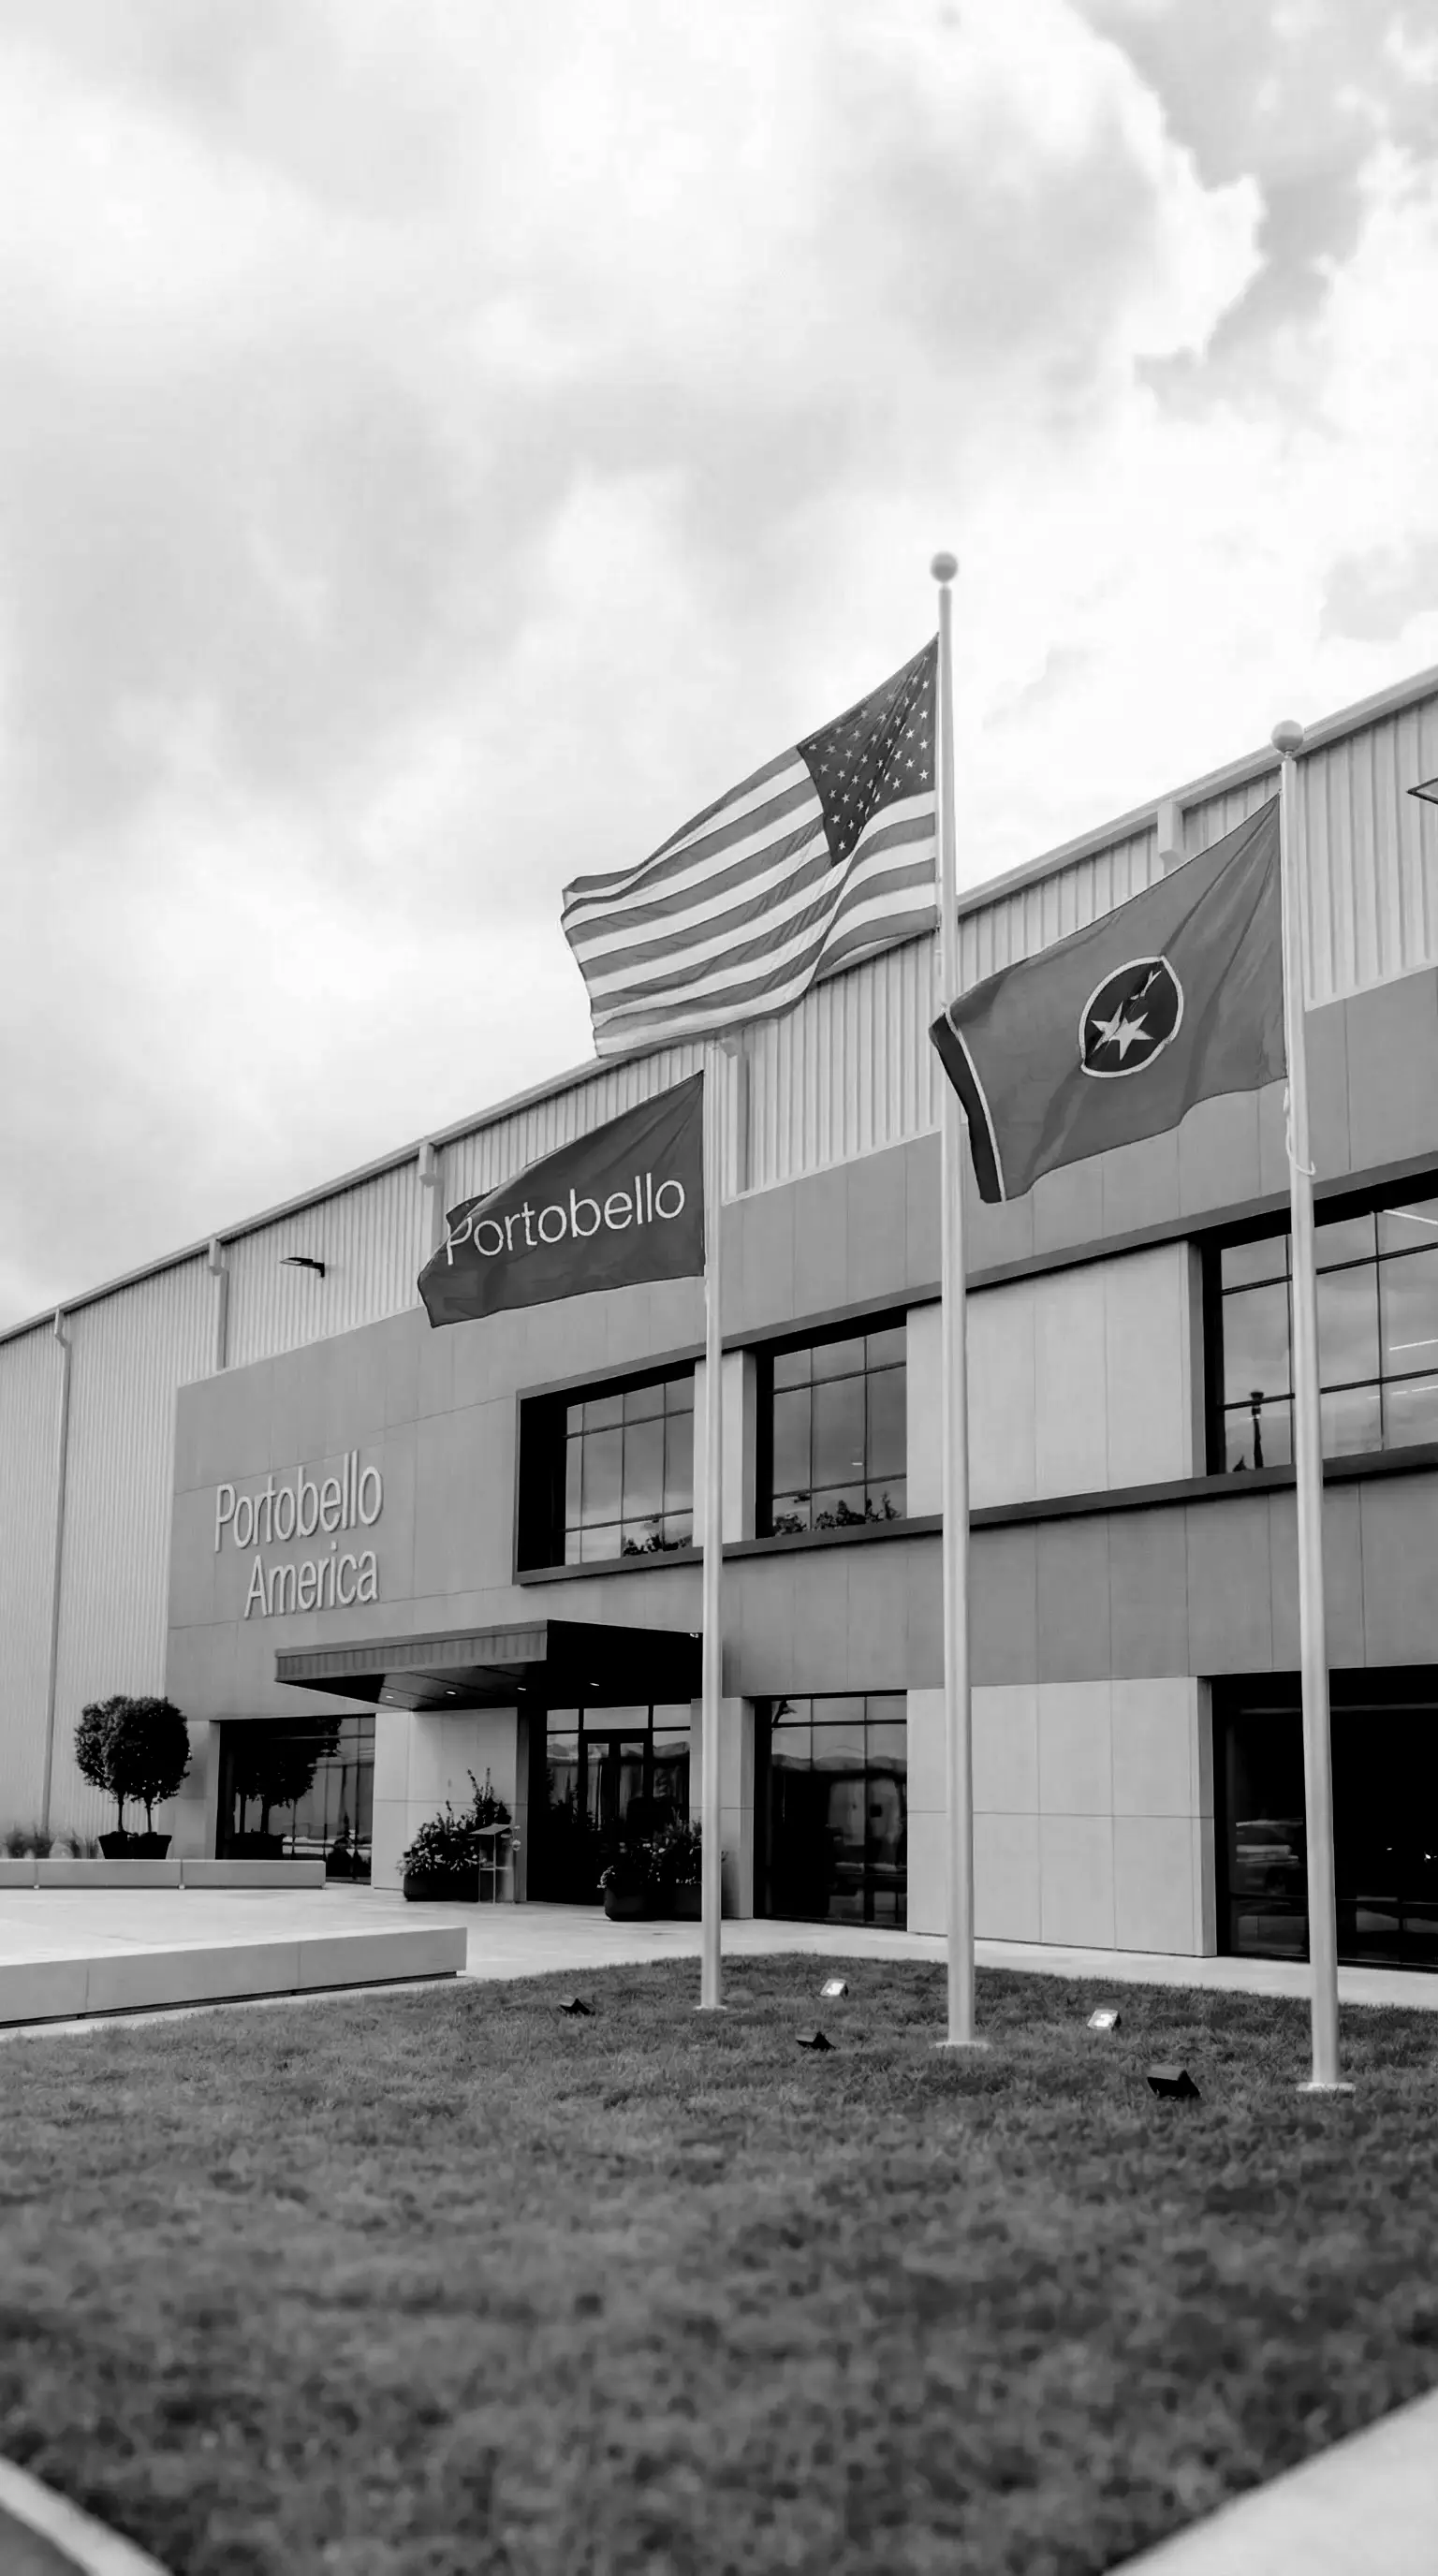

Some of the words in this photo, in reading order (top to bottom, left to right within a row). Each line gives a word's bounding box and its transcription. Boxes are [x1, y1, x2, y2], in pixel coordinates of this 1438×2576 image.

[447, 1173, 685, 1266] Portobello
[215, 1449, 383, 1553] Portobello
[243, 1540, 378, 1620] America
